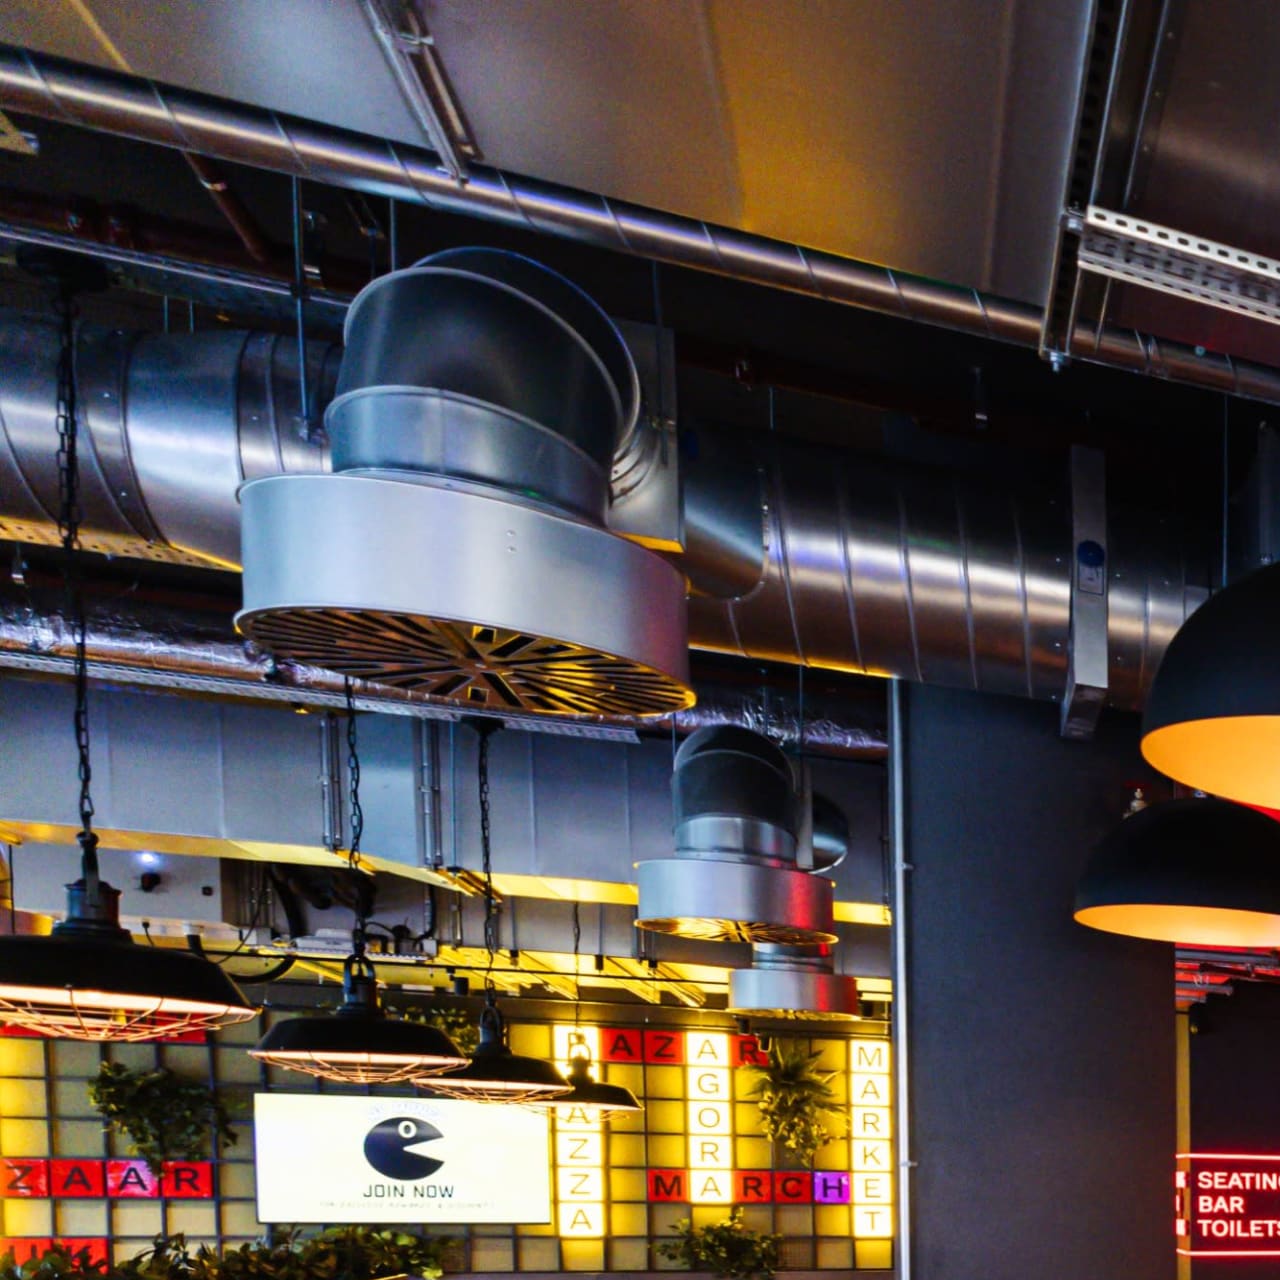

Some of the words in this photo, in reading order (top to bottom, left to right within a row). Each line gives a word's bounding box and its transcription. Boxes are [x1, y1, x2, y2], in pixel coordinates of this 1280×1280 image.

[697, 1039, 722, 1196] AGORA
[858, 1046, 882, 1231] MARKET
[363, 1184, 405, 1198] JOIN
[414, 1184, 455, 1199] NOW
[1198, 1195, 1245, 1213] BAR
